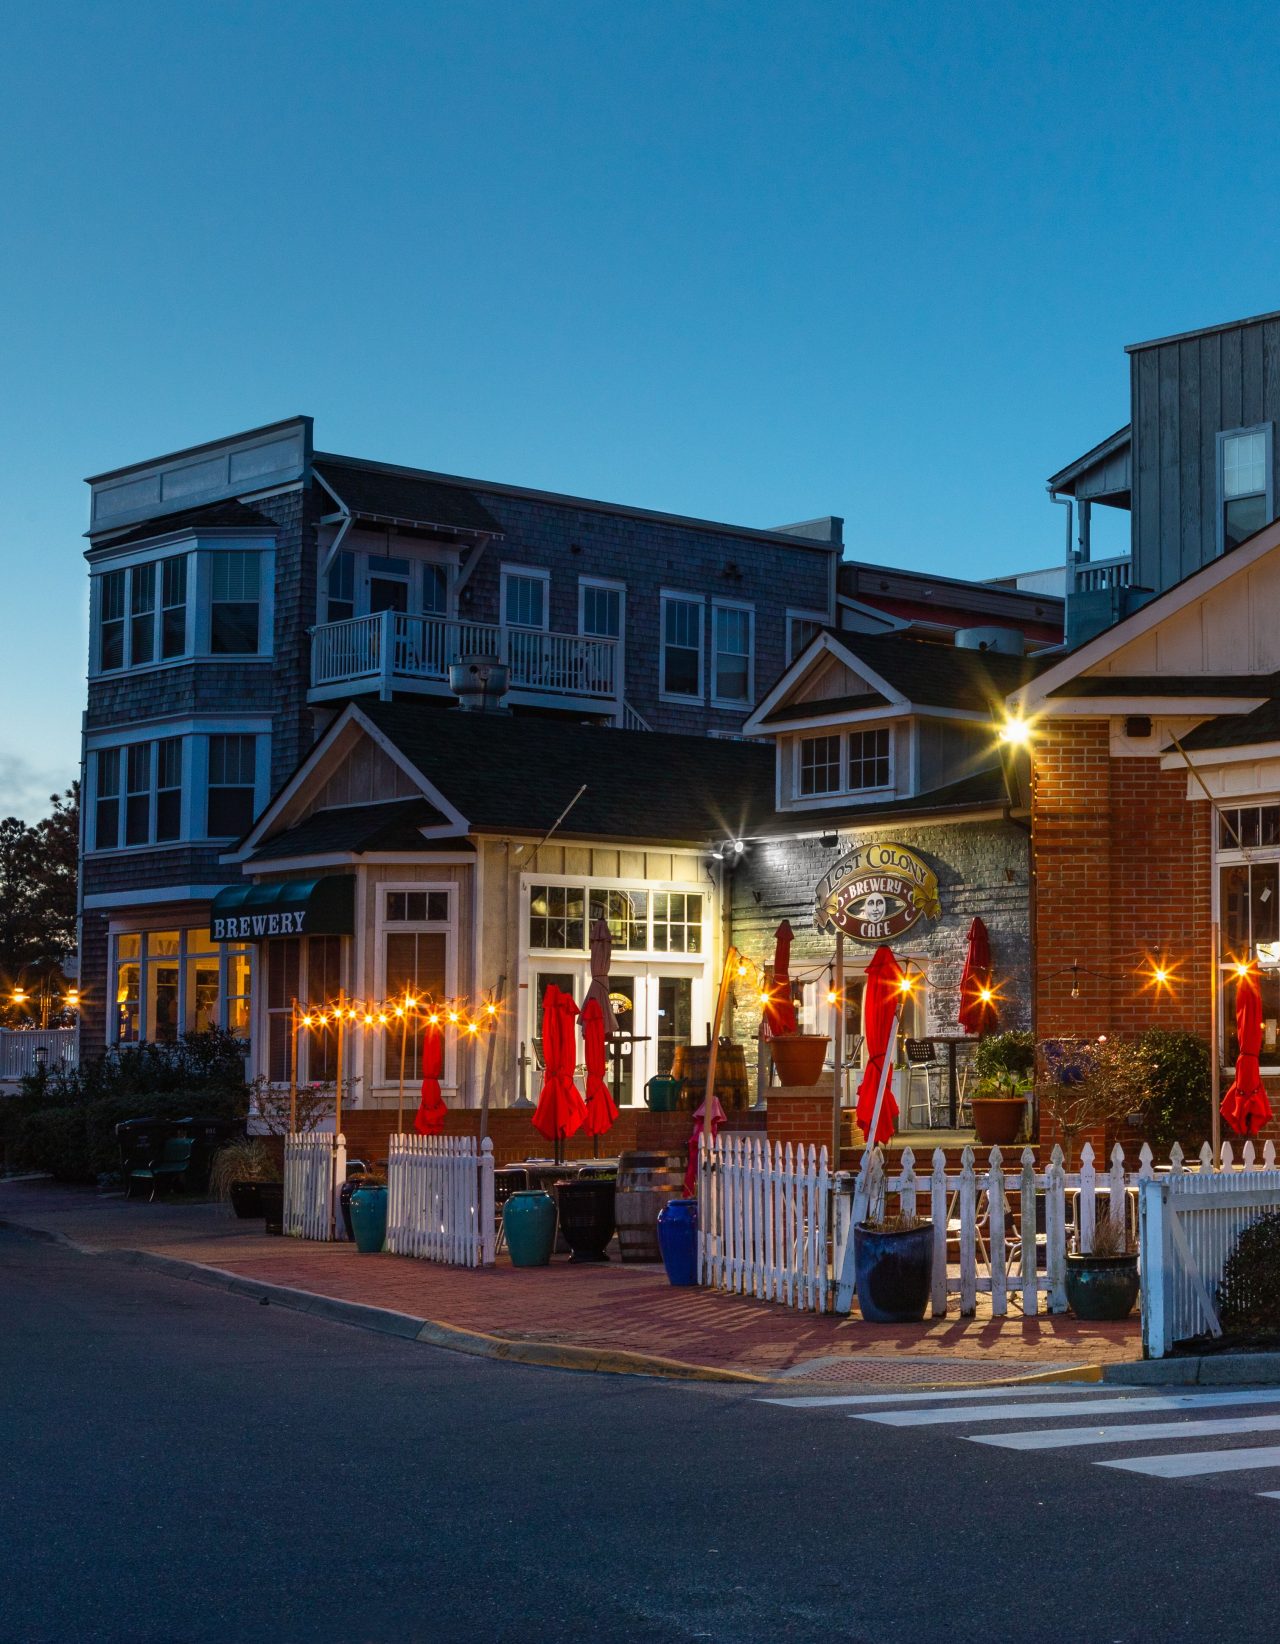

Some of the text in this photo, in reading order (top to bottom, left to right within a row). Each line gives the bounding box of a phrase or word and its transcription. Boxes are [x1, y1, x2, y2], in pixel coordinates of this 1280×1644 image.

[825, 844, 927, 898] LOST COLONY
[848, 877, 903, 899] BREWERY
[214, 911, 306, 939] BREWERY
[860, 921, 892, 938] CAFE
